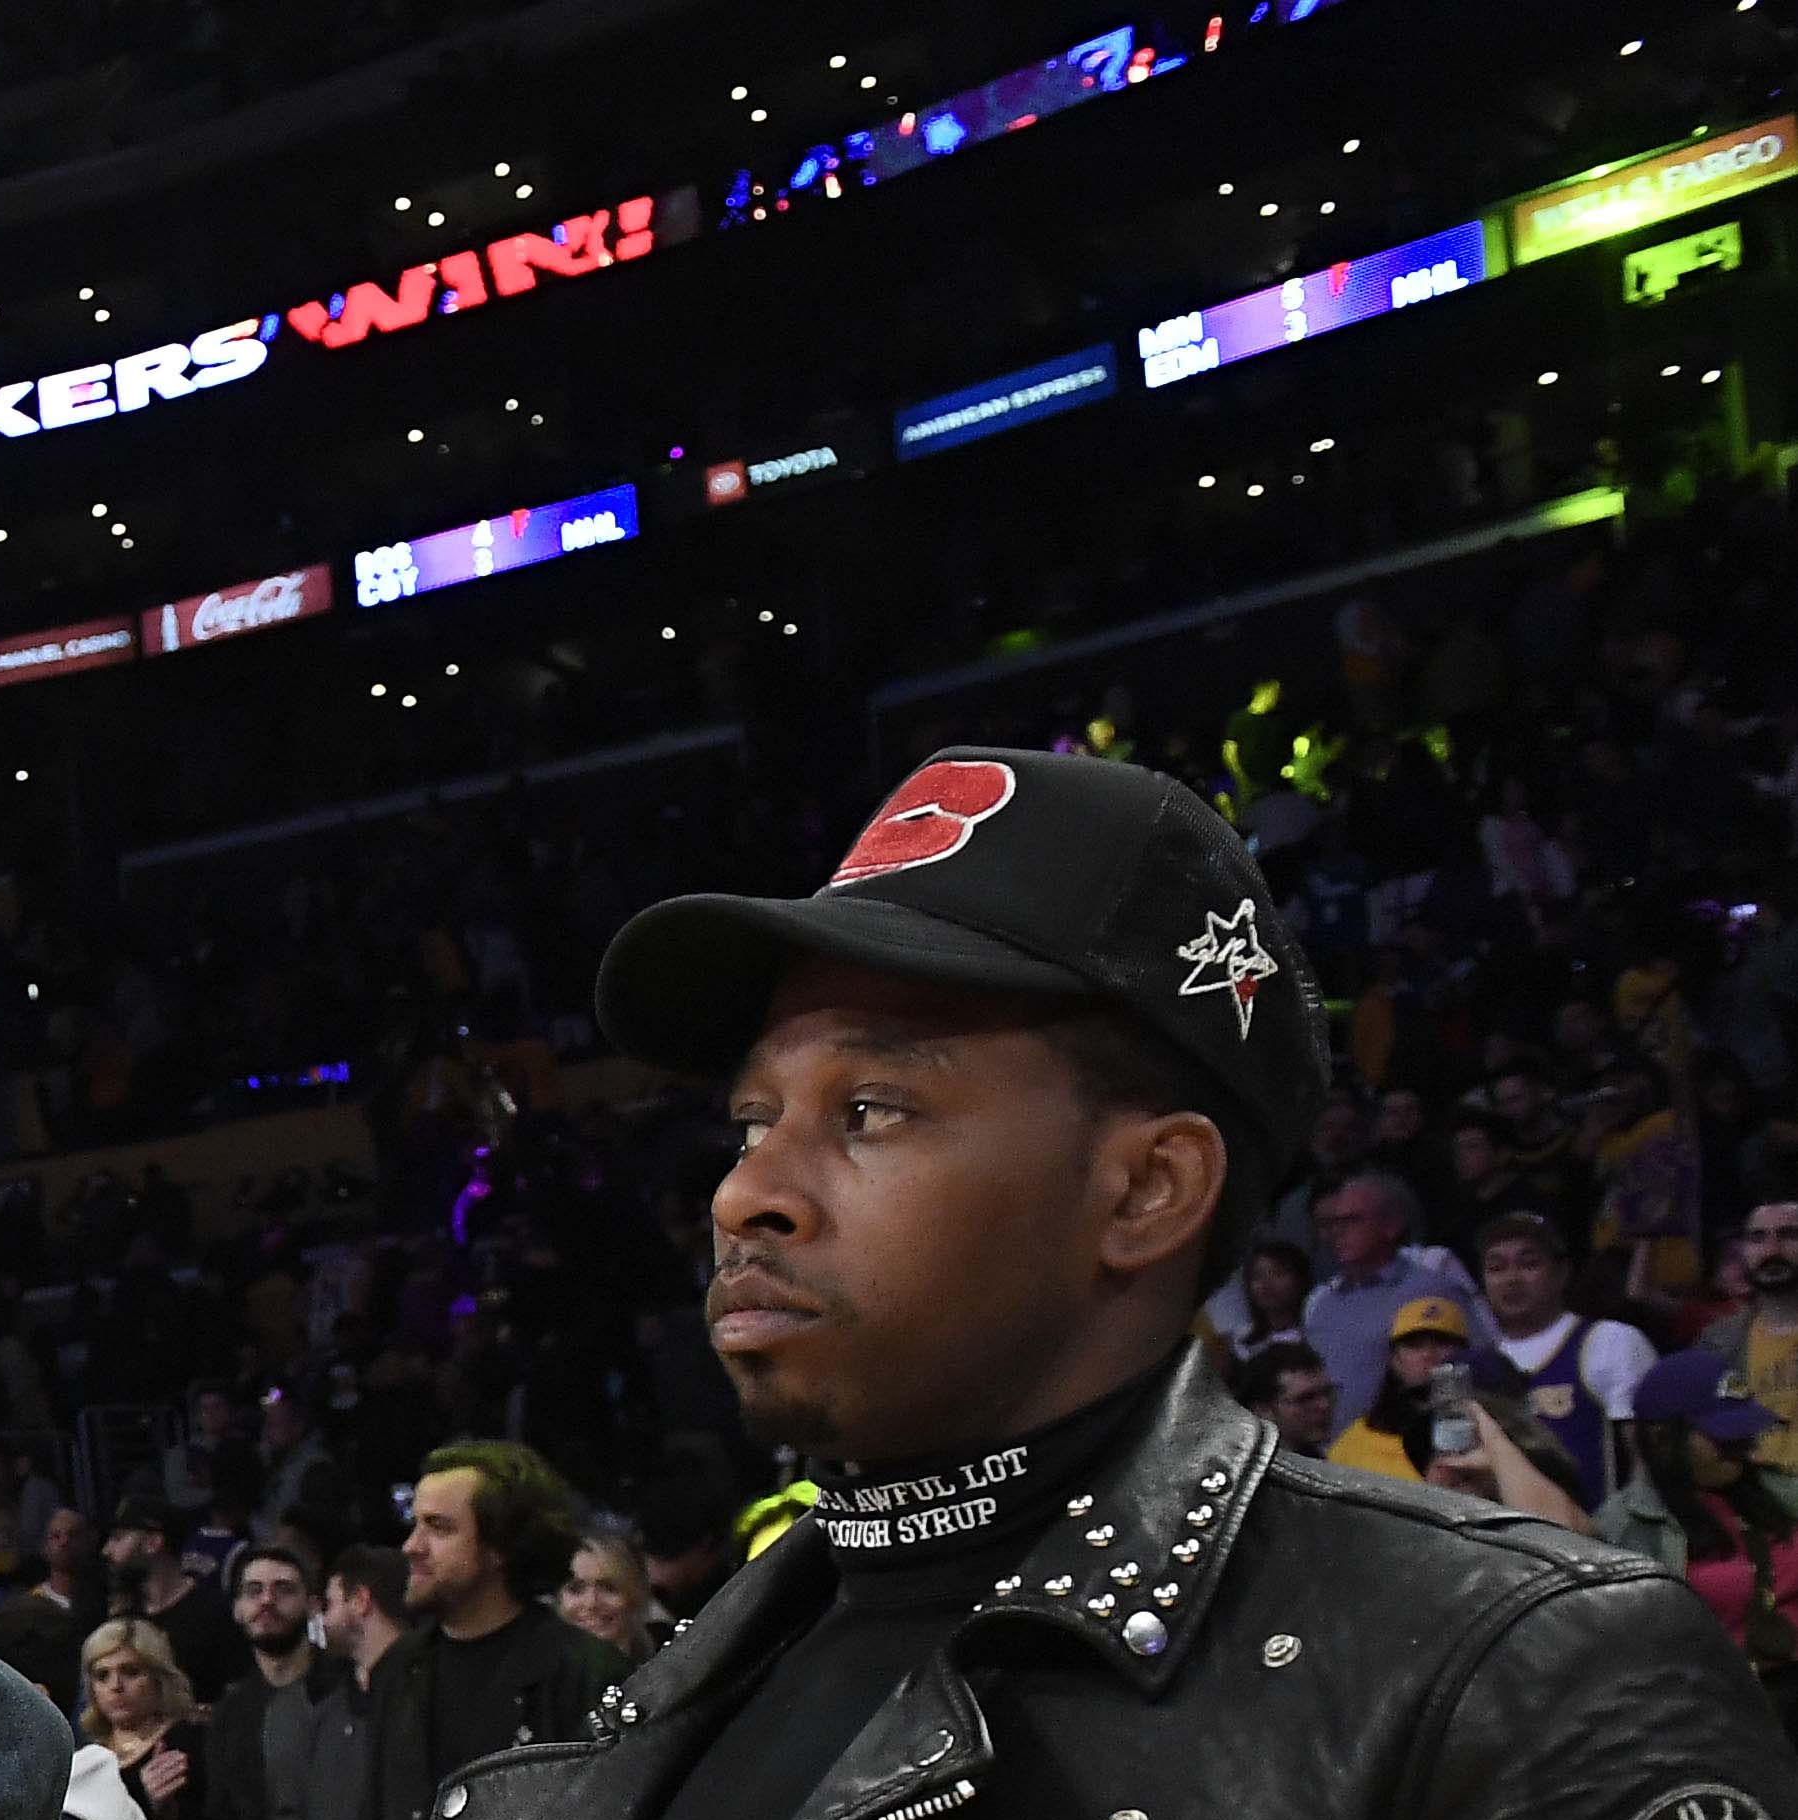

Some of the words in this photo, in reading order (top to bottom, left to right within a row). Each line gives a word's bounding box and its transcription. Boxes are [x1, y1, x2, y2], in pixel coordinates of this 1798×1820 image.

[1661, 134, 1783, 192] FARGO
[289, 196, 653, 349] WIN!
[748, 447, 838, 485] TOYOTA
[854, 1475, 957, 1513] AWFUL
[958, 1446, 1028, 1490] LOT
[828, 1519, 892, 1548] COUGH
[897, 1497, 997, 1543] SYRUP
